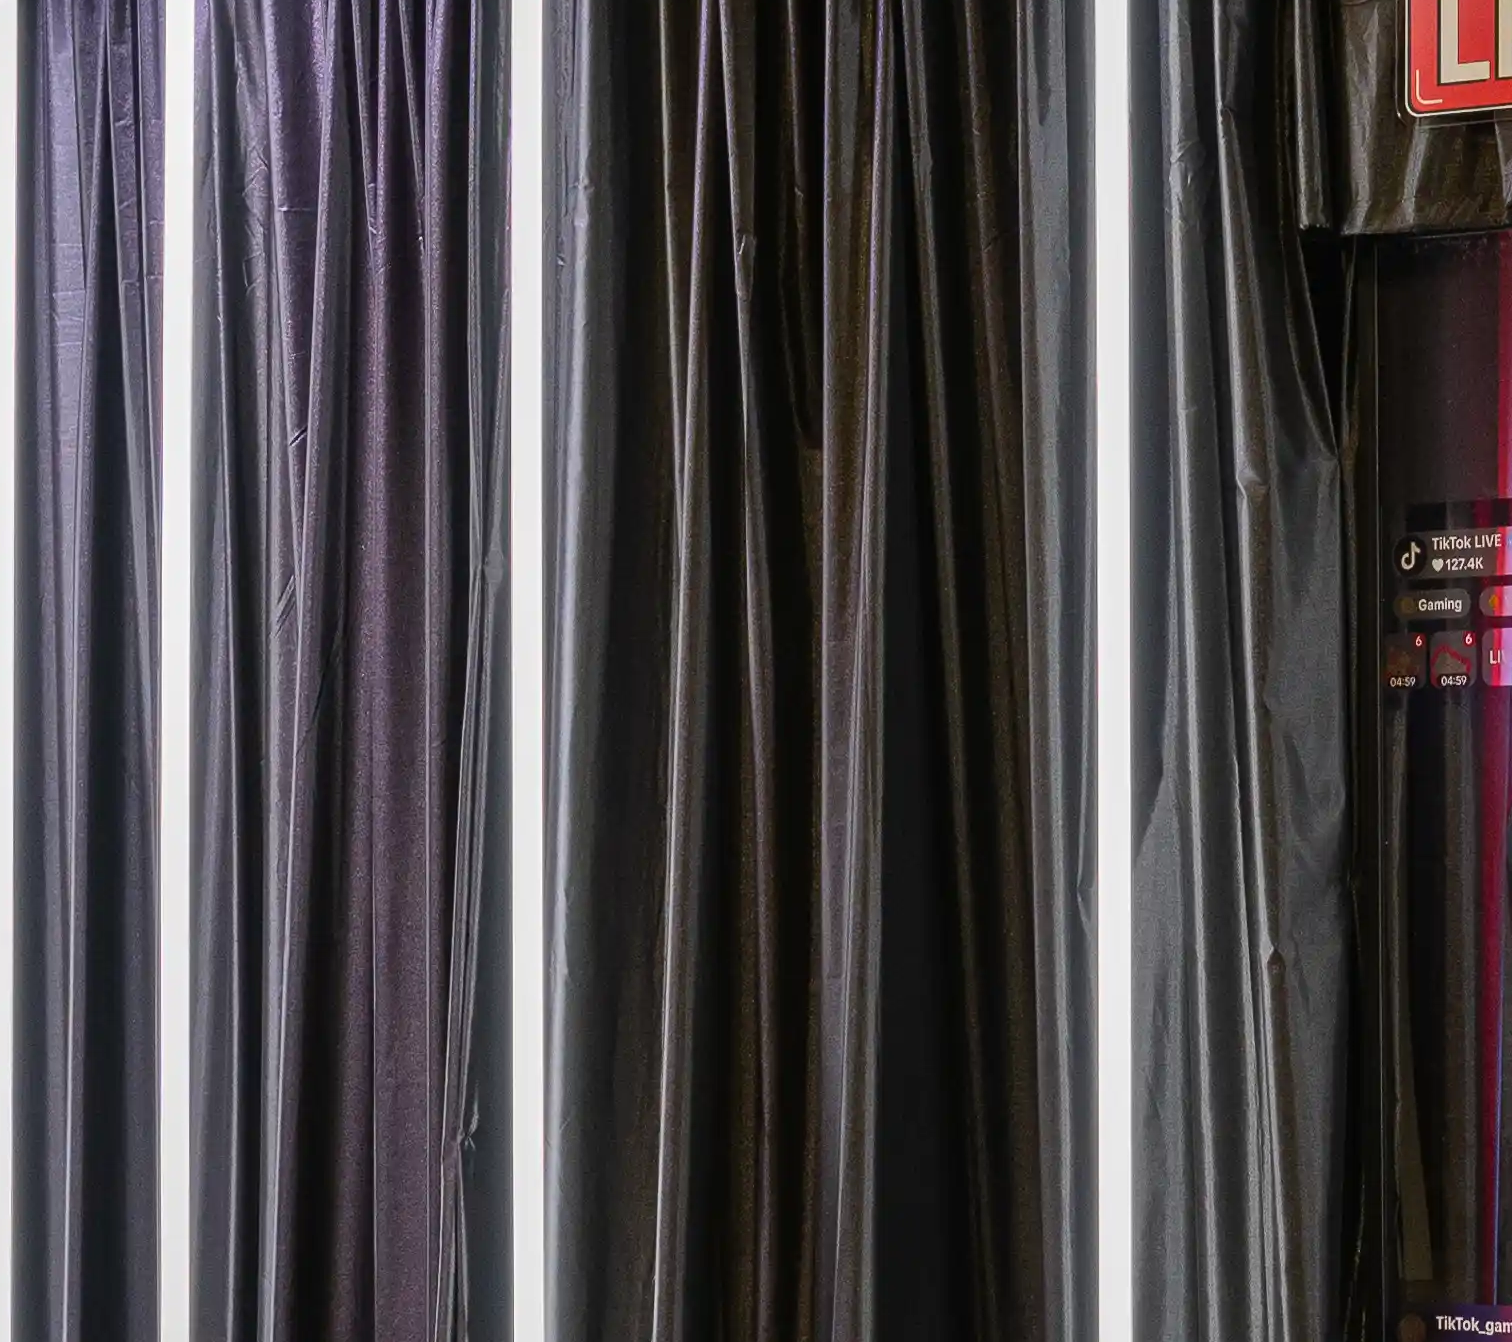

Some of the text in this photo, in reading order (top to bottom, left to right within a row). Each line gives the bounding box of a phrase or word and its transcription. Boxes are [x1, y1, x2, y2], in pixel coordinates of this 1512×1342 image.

[1432, 534, 1502, 551] TikTok LIVE
[1446, 557, 1483, 571] 127.4K
[1418, 599, 1462, 613] Gaming
[1415, 636, 1422, 646] 6
[1465, 634, 1473, 645] 6
[1390, 677, 1416, 687] 04:59
[1441, 676, 1467, 686] 04:59
